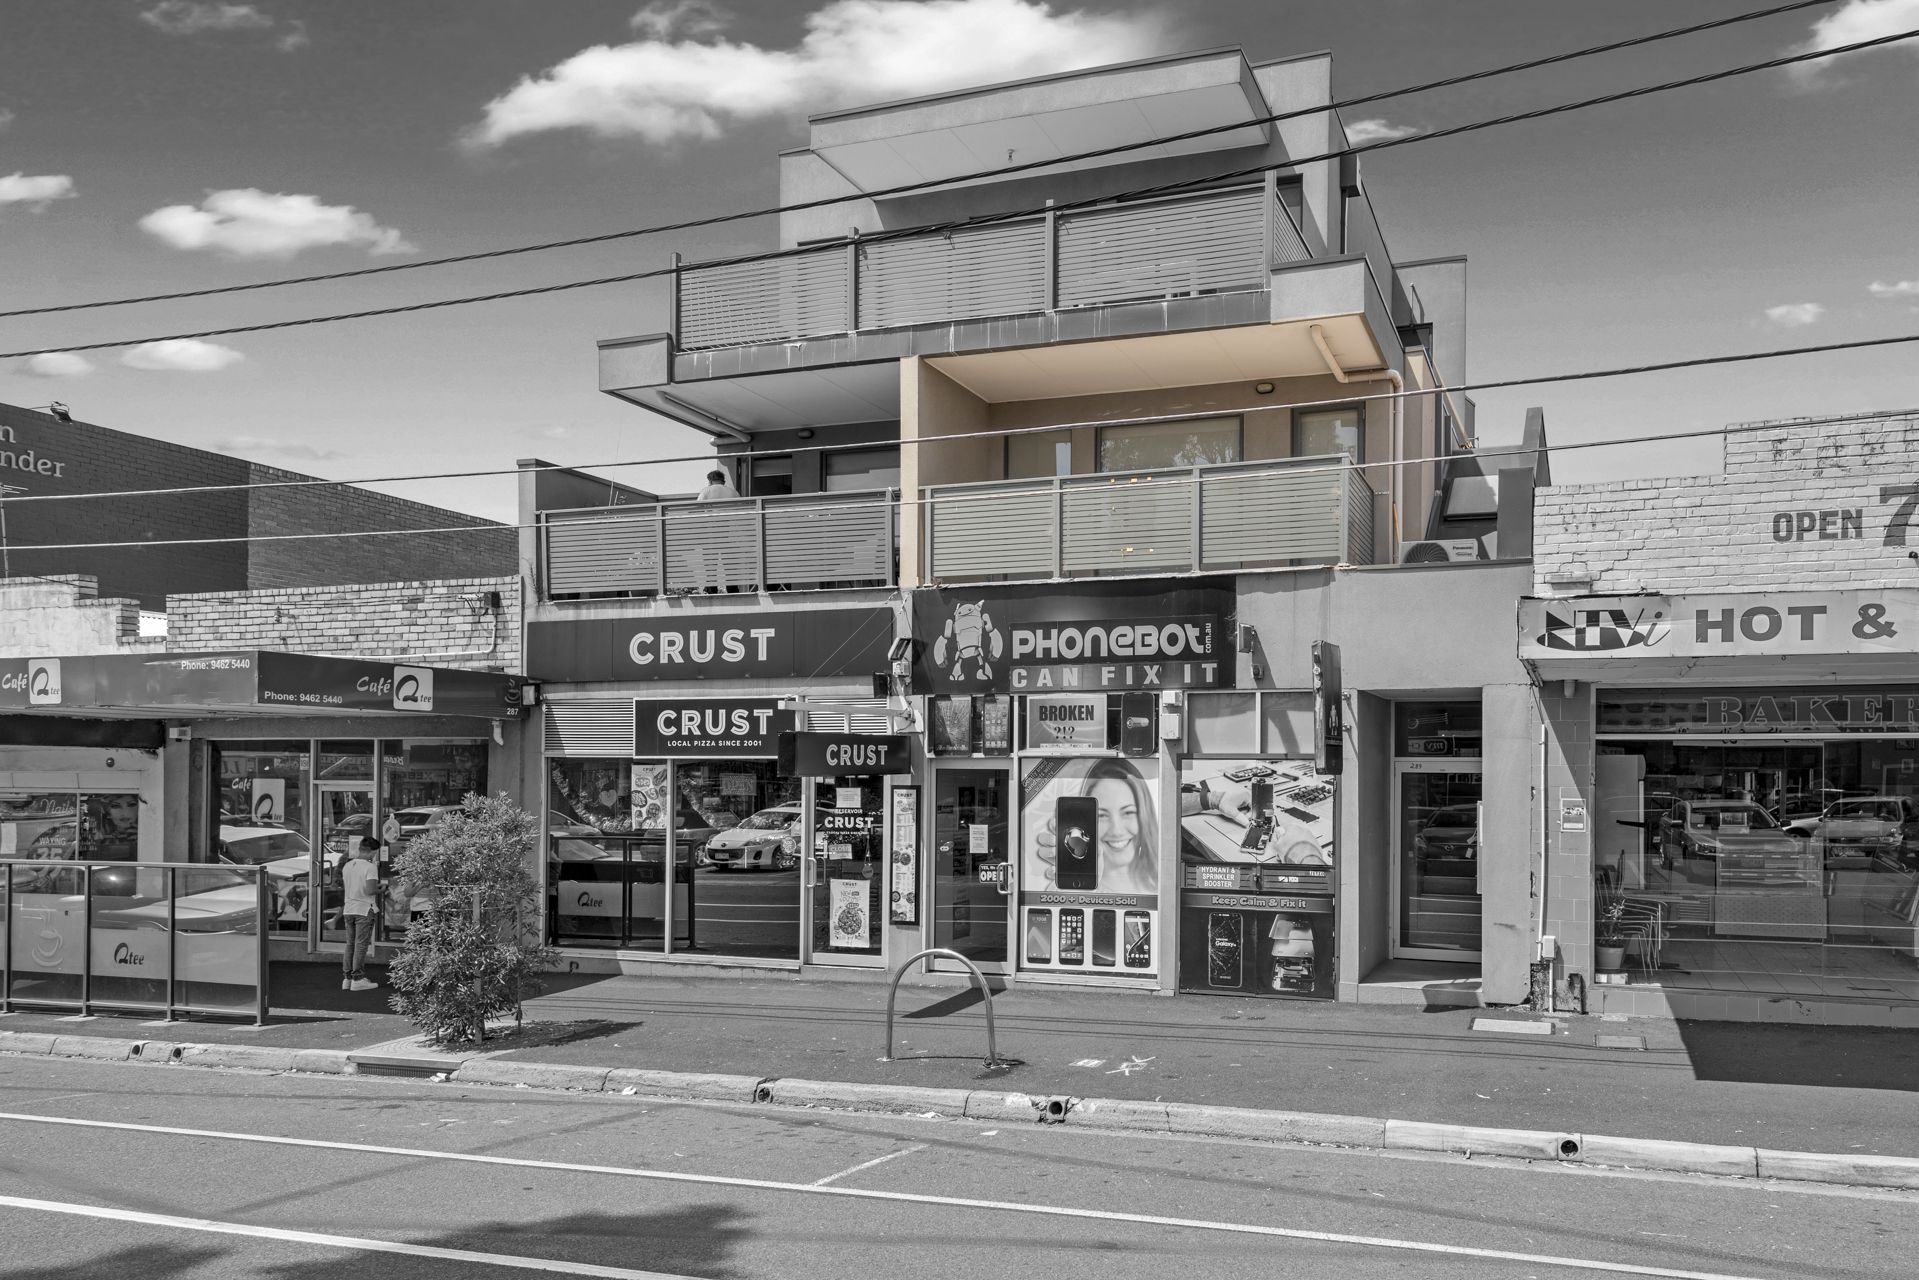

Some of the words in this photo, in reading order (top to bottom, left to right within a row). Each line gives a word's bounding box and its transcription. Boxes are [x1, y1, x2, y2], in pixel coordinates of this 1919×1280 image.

[0, 450, 65, 477] nder
[1773, 509, 1863, 542] OPEN
[1695, 605, 1827, 643] HOT
[1852, 603, 1898, 640] &
[629, 628, 776, 665] CRUST
[181, 660, 209, 670] Phone:
[211, 660, 230, 669] 9462
[231, 659, 250, 669] 5440
[1, 673, 28, 692] Café
[1012, 667, 1078, 688] CAN
[1101, 664, 1160, 686] FIX
[1184, 663, 1218, 683] IT
[356, 677, 392, 696] Café
[264, 690, 298, 701] Phone:
[299, 693, 321, 703] 9462
[322, 694, 343, 704] 5440
[506, 708, 519, 716] 287
[1039, 705, 1095, 722] BROKEN
[657, 709, 773, 736] CRUST
[826, 744, 888, 766] CRUST
[231, 778, 251, 791] Café
[824, 817, 874, 828] CRUST
[1201, 866, 1229, 874] HYDRANT
[1040, 894, 1066, 903] 2000
[1078, 895, 1114, 905] Devices
[1115, 897, 1137, 905] Sold
[1212, 896, 1237, 906] Keep
[1240, 897, 1266, 906] Calm
[1268, 899, 1277, 907] &
[1298, 899, 1306, 908] it
[1215, 940, 1234, 948] Galaxy
